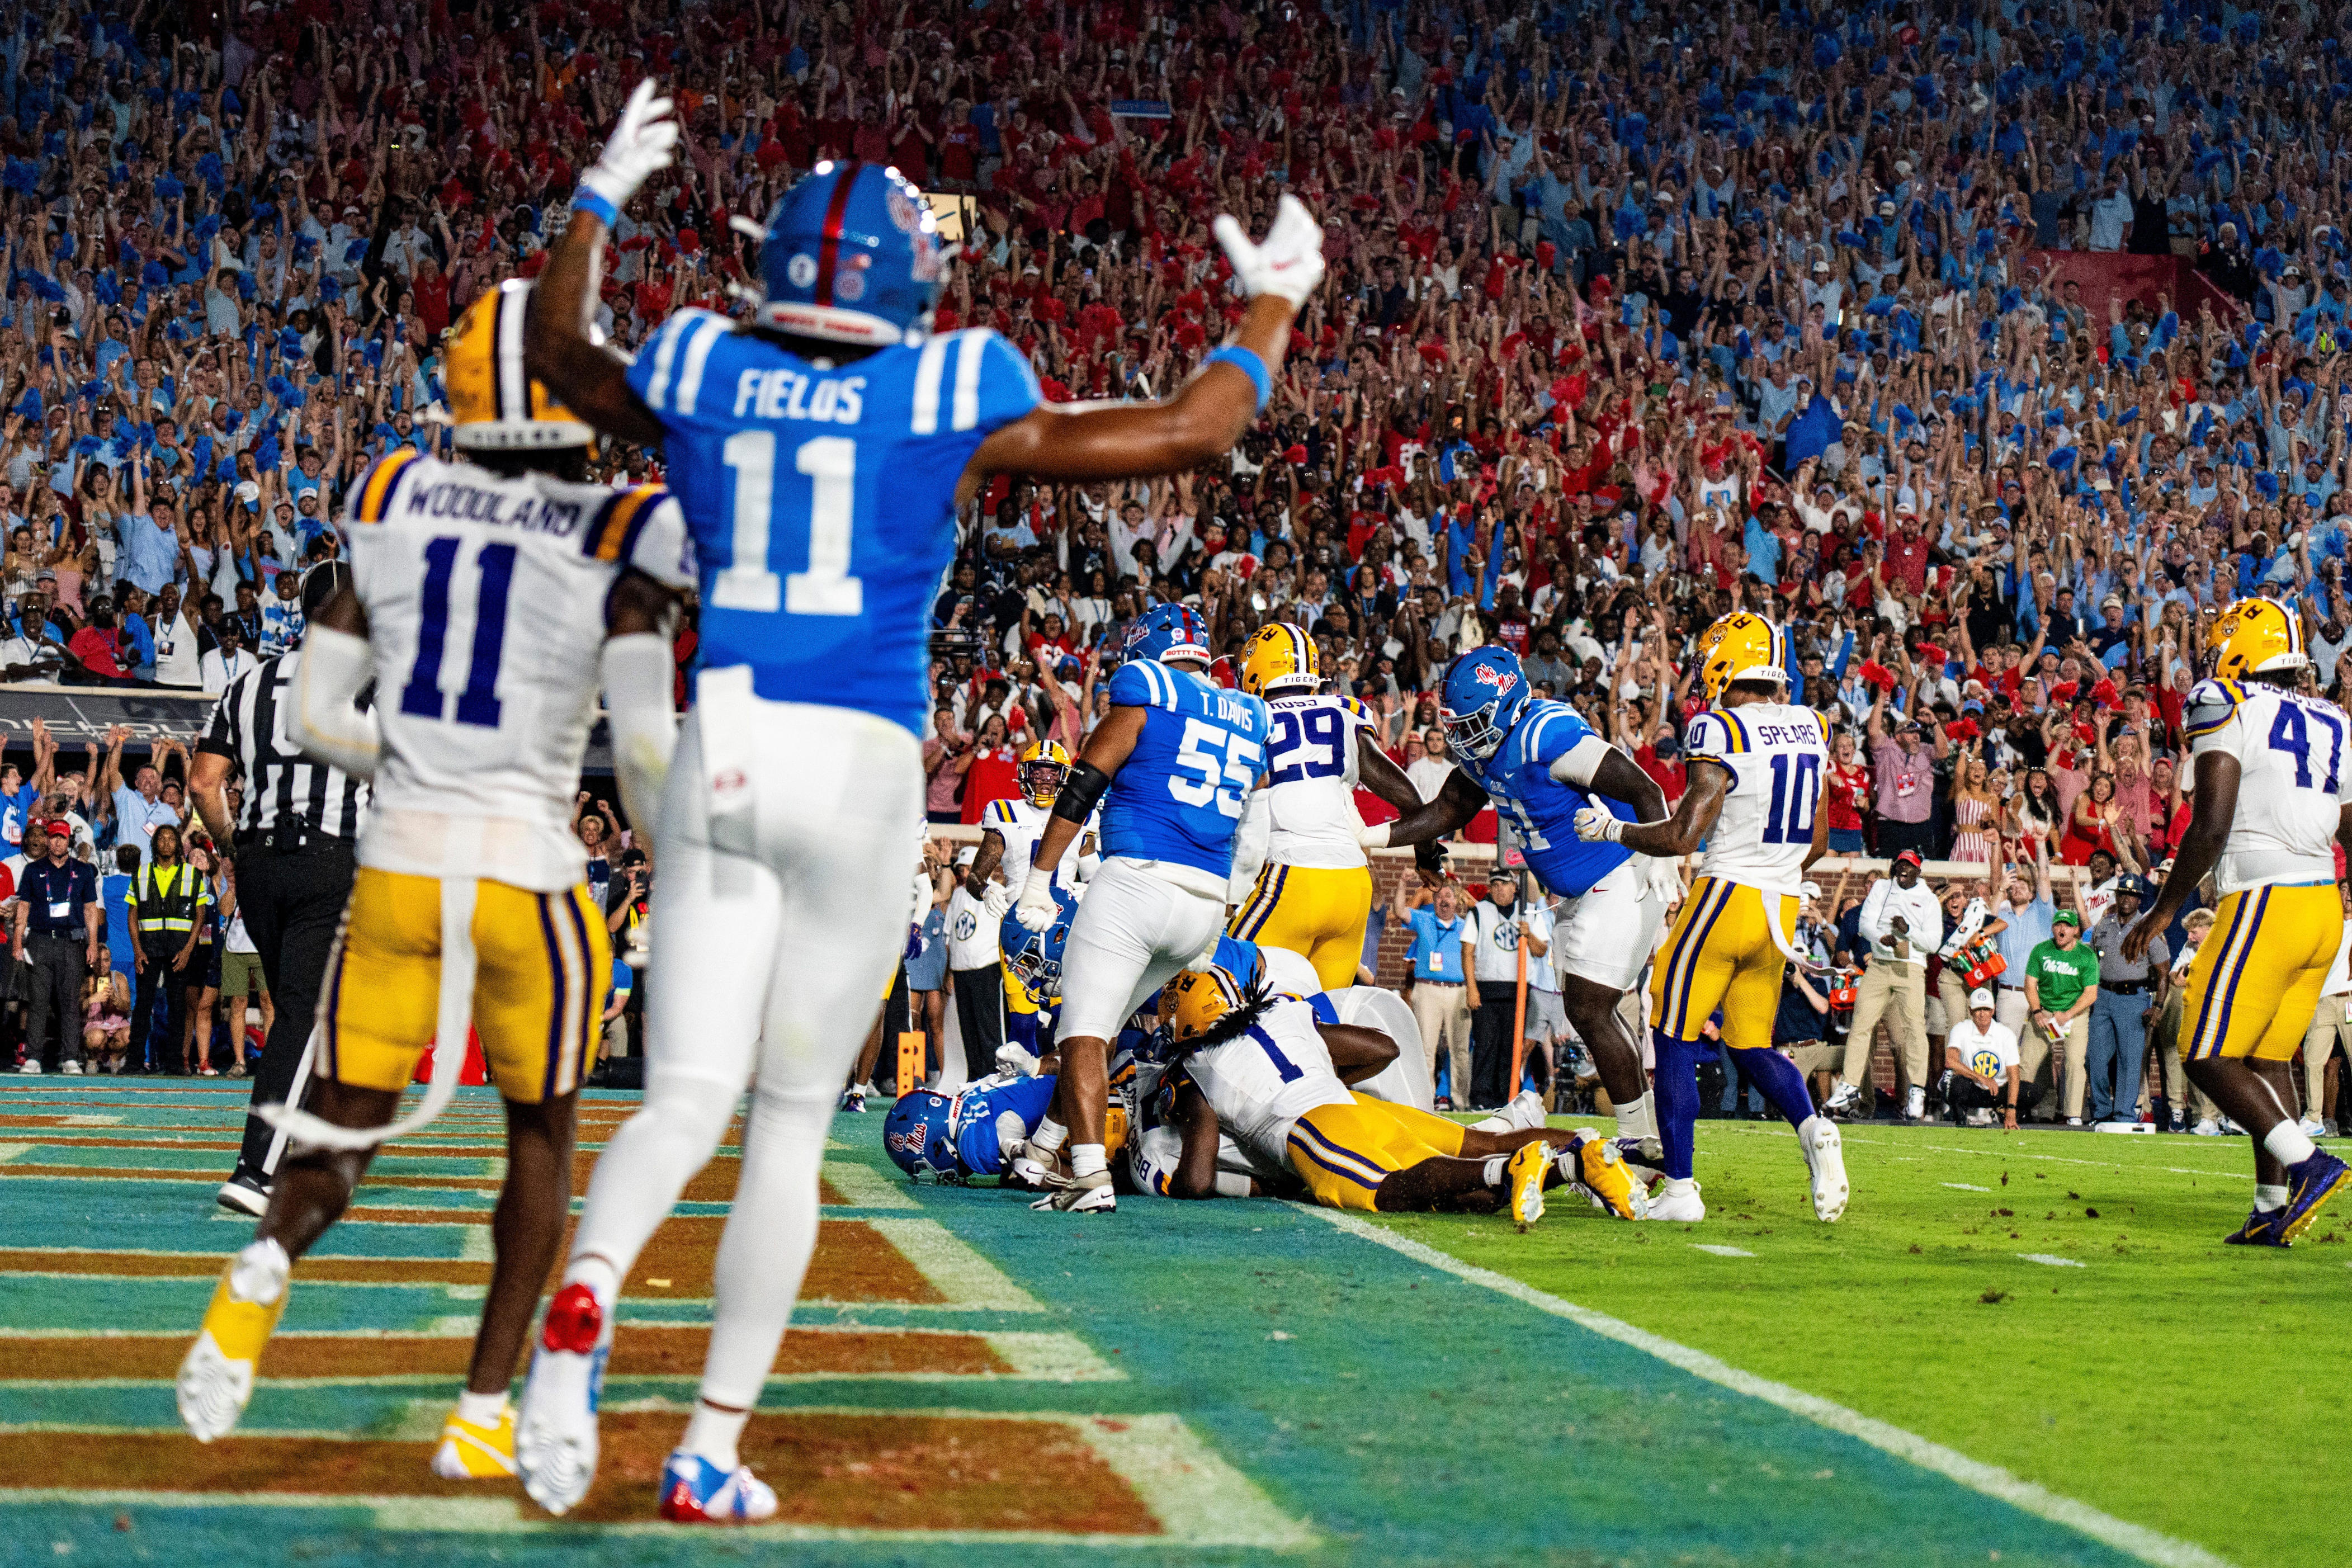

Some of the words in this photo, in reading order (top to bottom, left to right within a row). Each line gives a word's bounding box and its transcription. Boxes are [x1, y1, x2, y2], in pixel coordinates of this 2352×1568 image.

[733, 368, 867, 424] FIELDS
[405, 478, 582, 536] WOODLAND
[711, 429, 863, 617] 11
[400, 535, 517, 726] 11
[1476, 663, 1497, 684] Ole
[1493, 670, 1518, 696] Miss
[1200, 691, 1213, 717] T.
[1217, 696, 1253, 733] DAVIS
[1758, 724, 1817, 746] SPEARS
[1168, 716, 1261, 819] 55
[1265, 706, 1345, 789] 29
[2268, 698, 2343, 795] 47
[1761, 753, 1820, 844] 10
[1839, 989, 1849, 1001] G
[1244, 1023, 1305, 1085] 1
[1974, 1052, 1998, 1079] SEC
[889, 1131, 905, 1153] Ole
[904, 1122, 928, 1151] Miss
